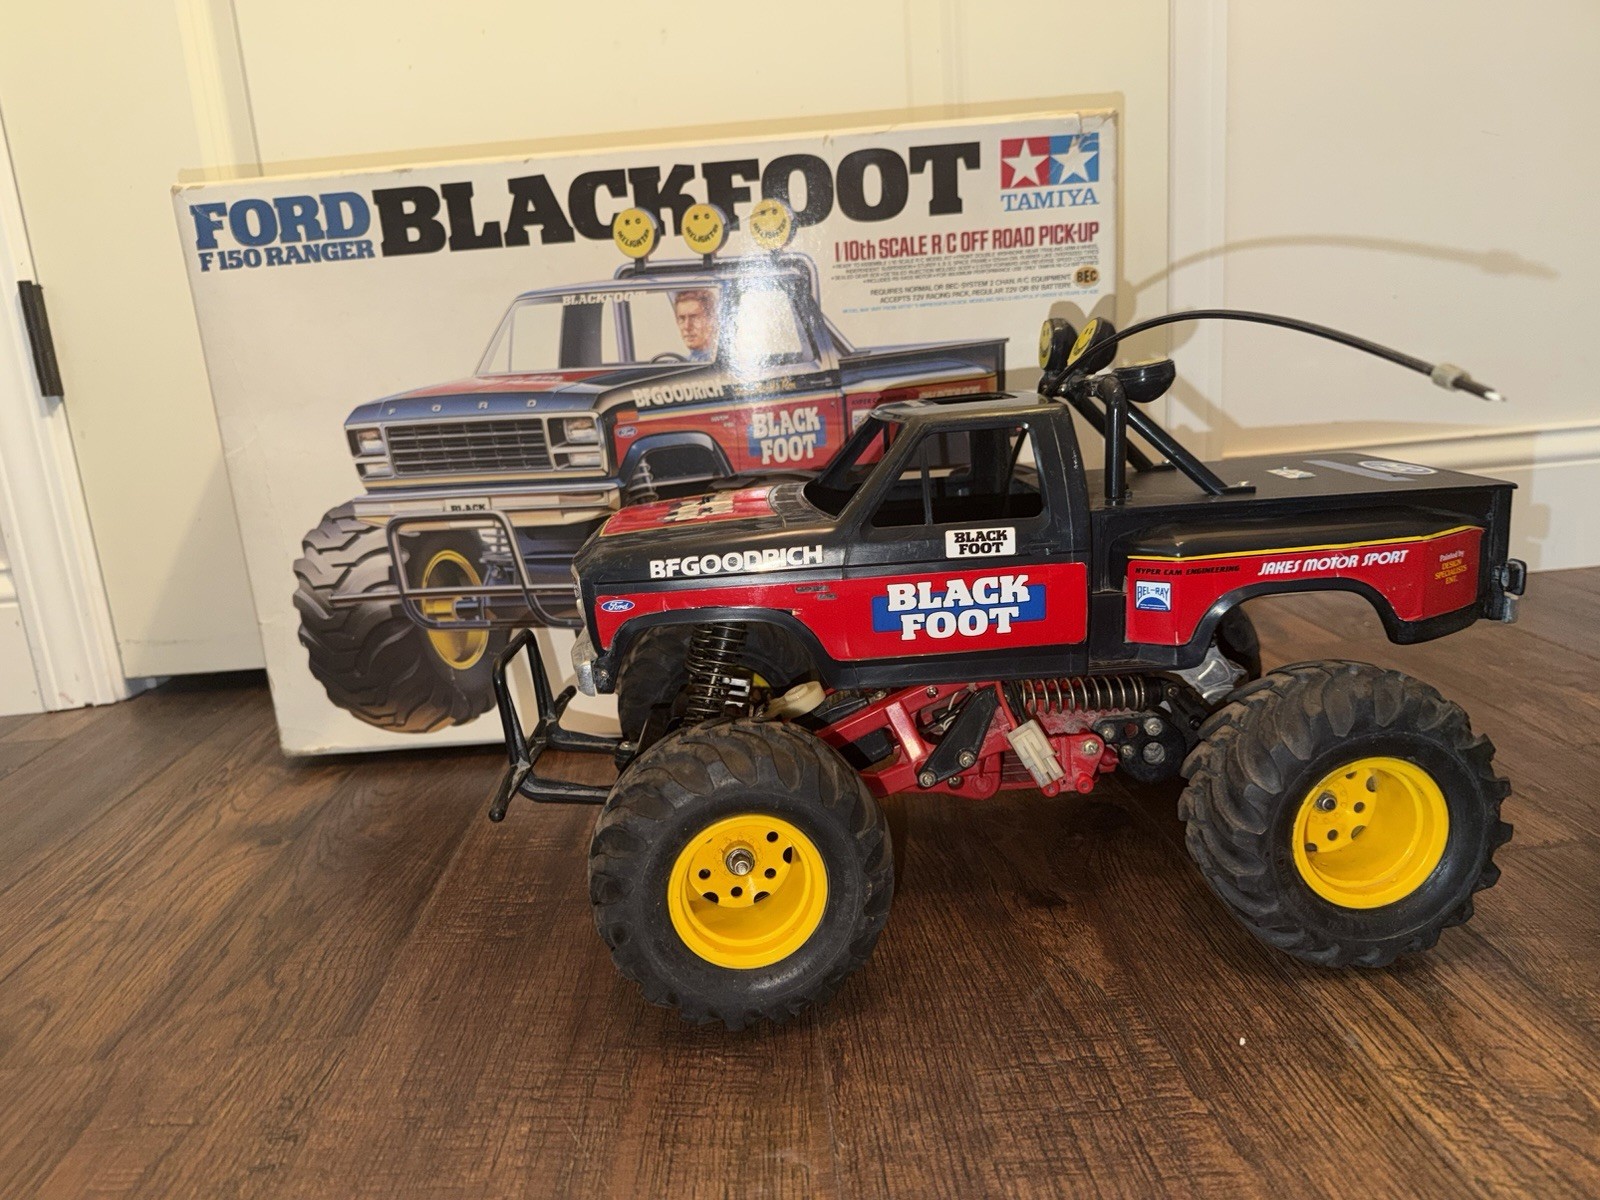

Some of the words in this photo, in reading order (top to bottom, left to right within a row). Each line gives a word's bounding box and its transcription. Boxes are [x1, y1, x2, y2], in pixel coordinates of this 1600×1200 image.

[190, 191, 371, 249] FORD
[372, 142, 981, 257] BLACKFOOT
[1001, 187, 1100, 212] TAMIYA
[264, 240, 376, 267] RANGER
[879, 235, 928, 259] SCALE
[960, 230, 989, 253] OFF
[992, 226, 1035, 250] ROAD
[1039, 221, 1100, 246] PICK-UP
[1076, 269, 1097, 284] BEC
[632, 379, 725, 407] BFGOODRICH
[751, 406, 821, 440] BLACK
[760, 433, 817, 466] FOOT
[954, 529, 1008, 544] BLACK
[959, 541, 1004, 555] FOOT
[649, 544, 824, 579] BFGOODRICH
[1186, 564, 1240, 575] ENGINEERING
[1257, 559, 1302, 576] JAKES
[1302, 554, 1359, 573] MOTOR
[1361, 549, 1409, 567] SPORT
[886, 574, 1031, 612] BLACK
[1137, 585, 1169, 601] BEL-RAY
[900, 606, 1020, 641] FOOT
